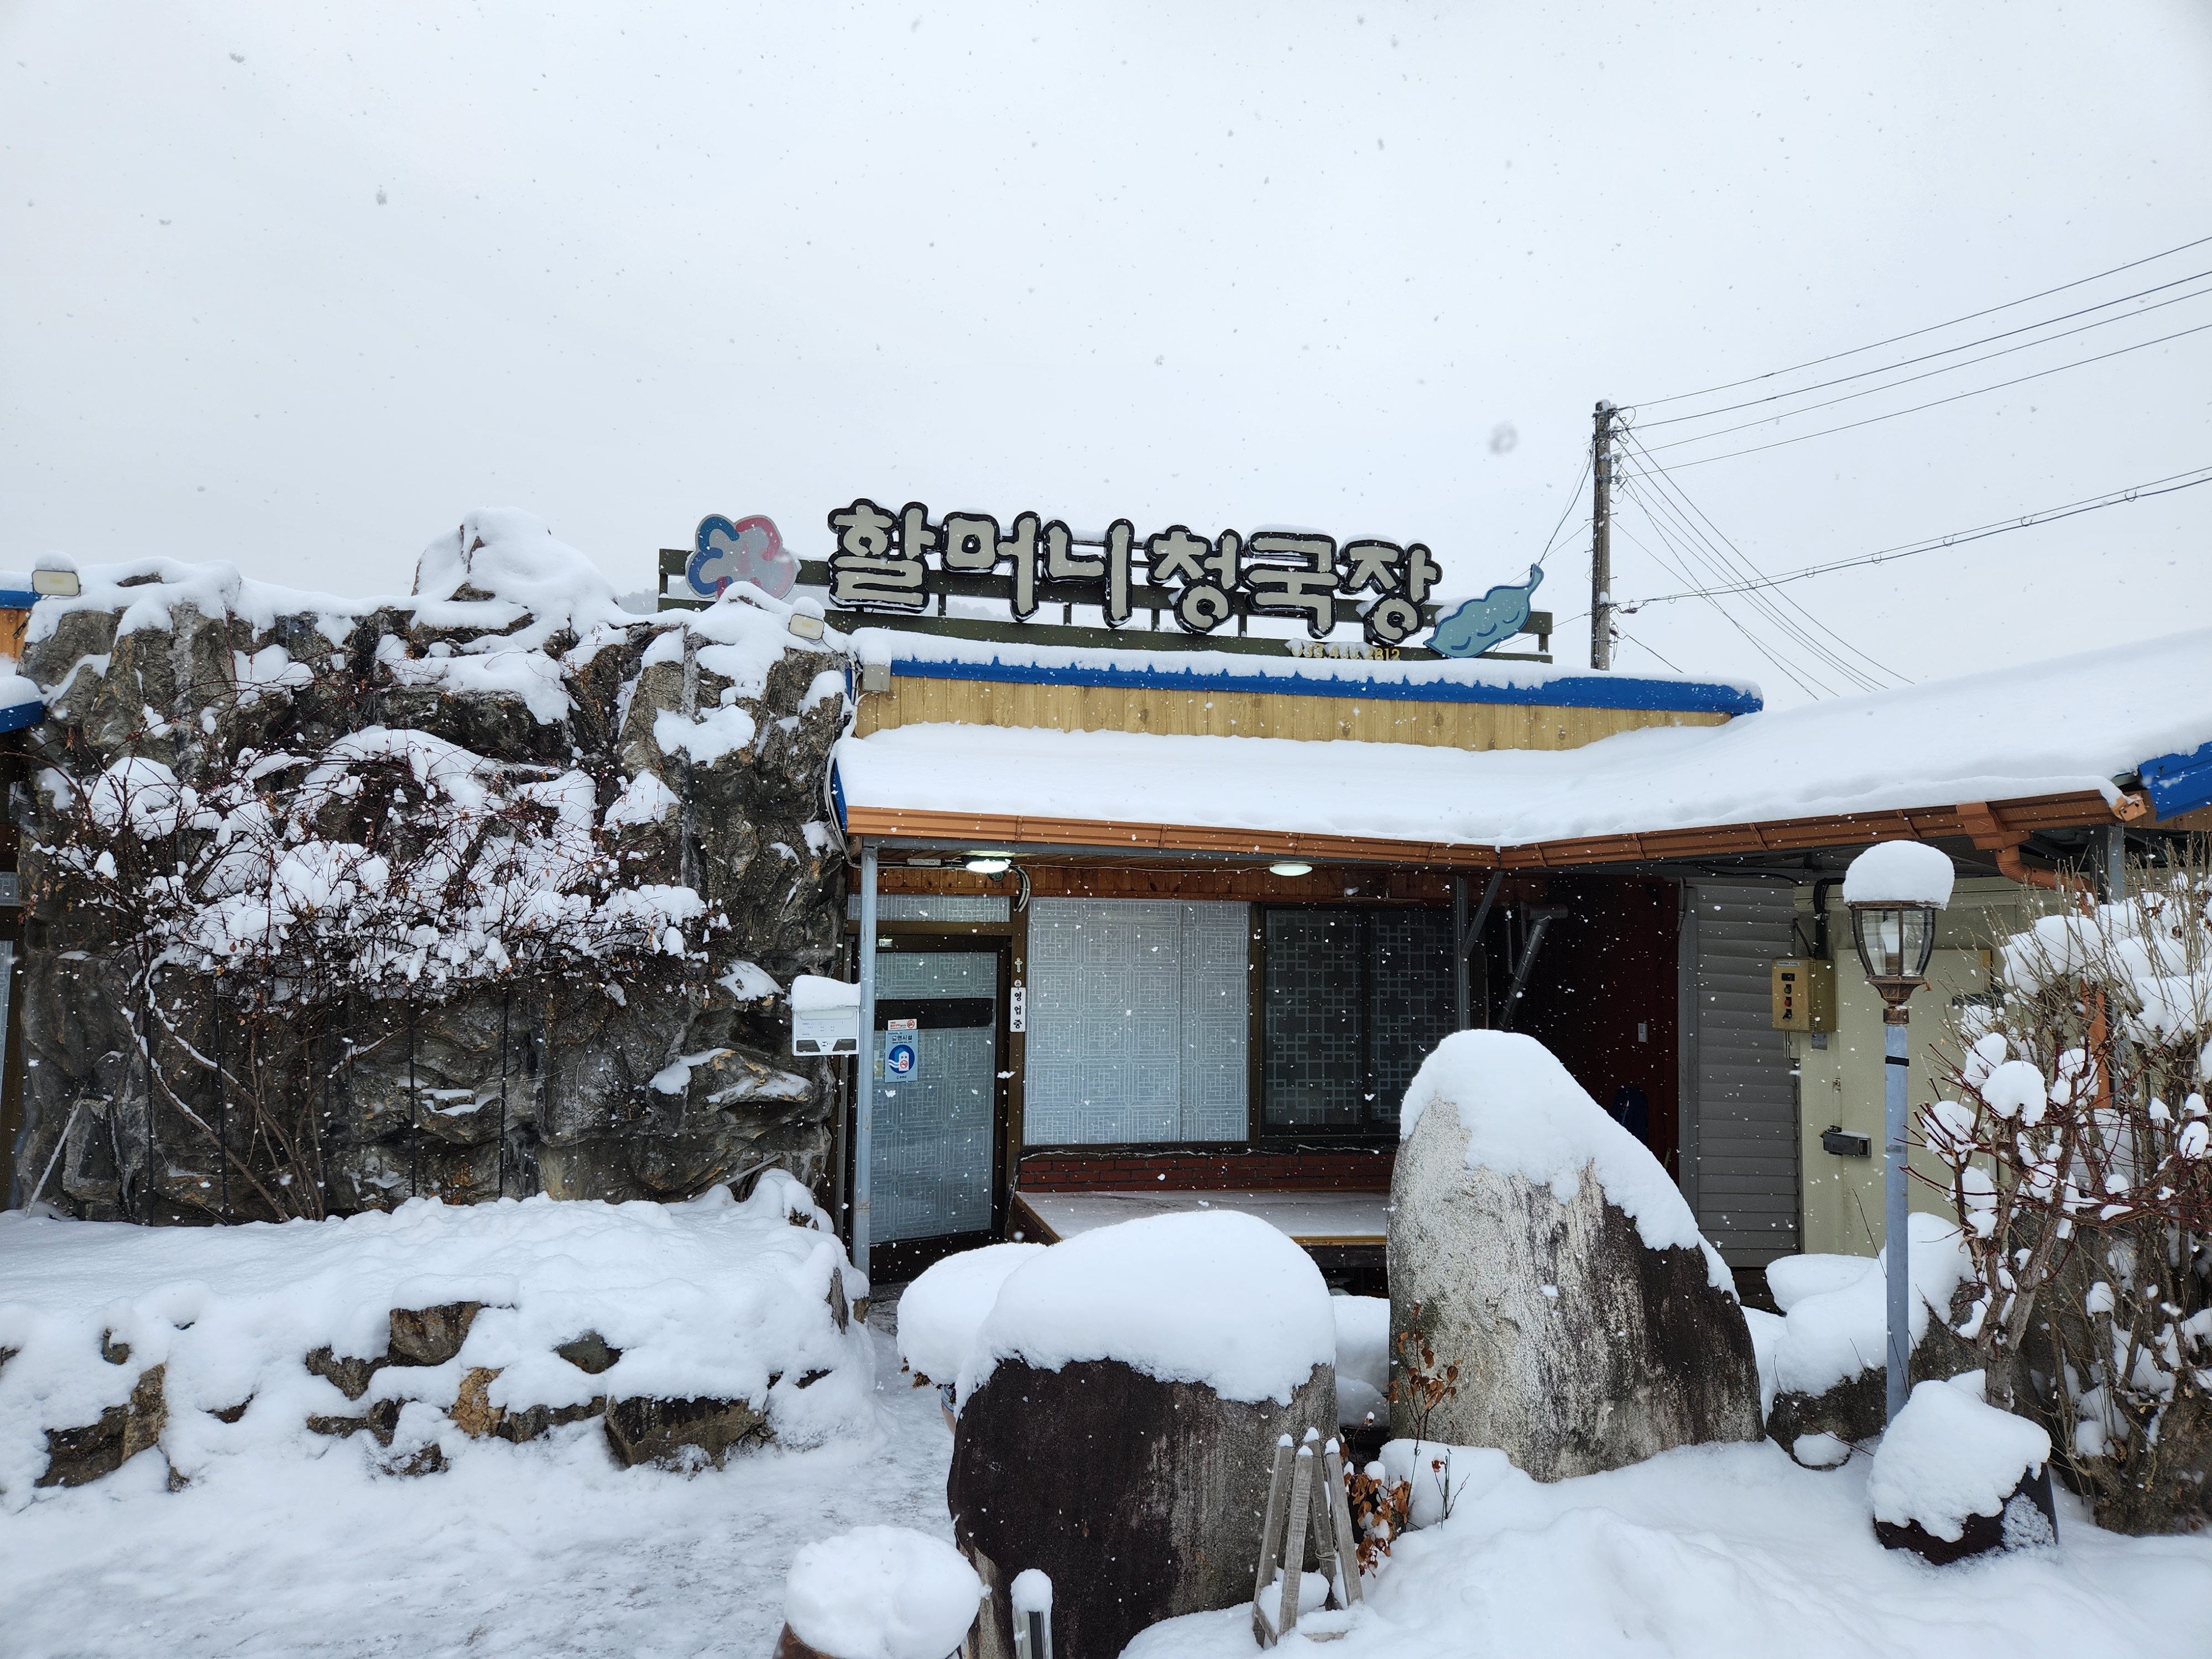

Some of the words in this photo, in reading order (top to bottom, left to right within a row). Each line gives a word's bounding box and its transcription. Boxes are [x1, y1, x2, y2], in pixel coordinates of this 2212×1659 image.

[828, 498, 1443, 645] 할머니청국장
[1366, 648, 1400, 661] 2812
[1013, 992, 1022, 1029] 영업중
